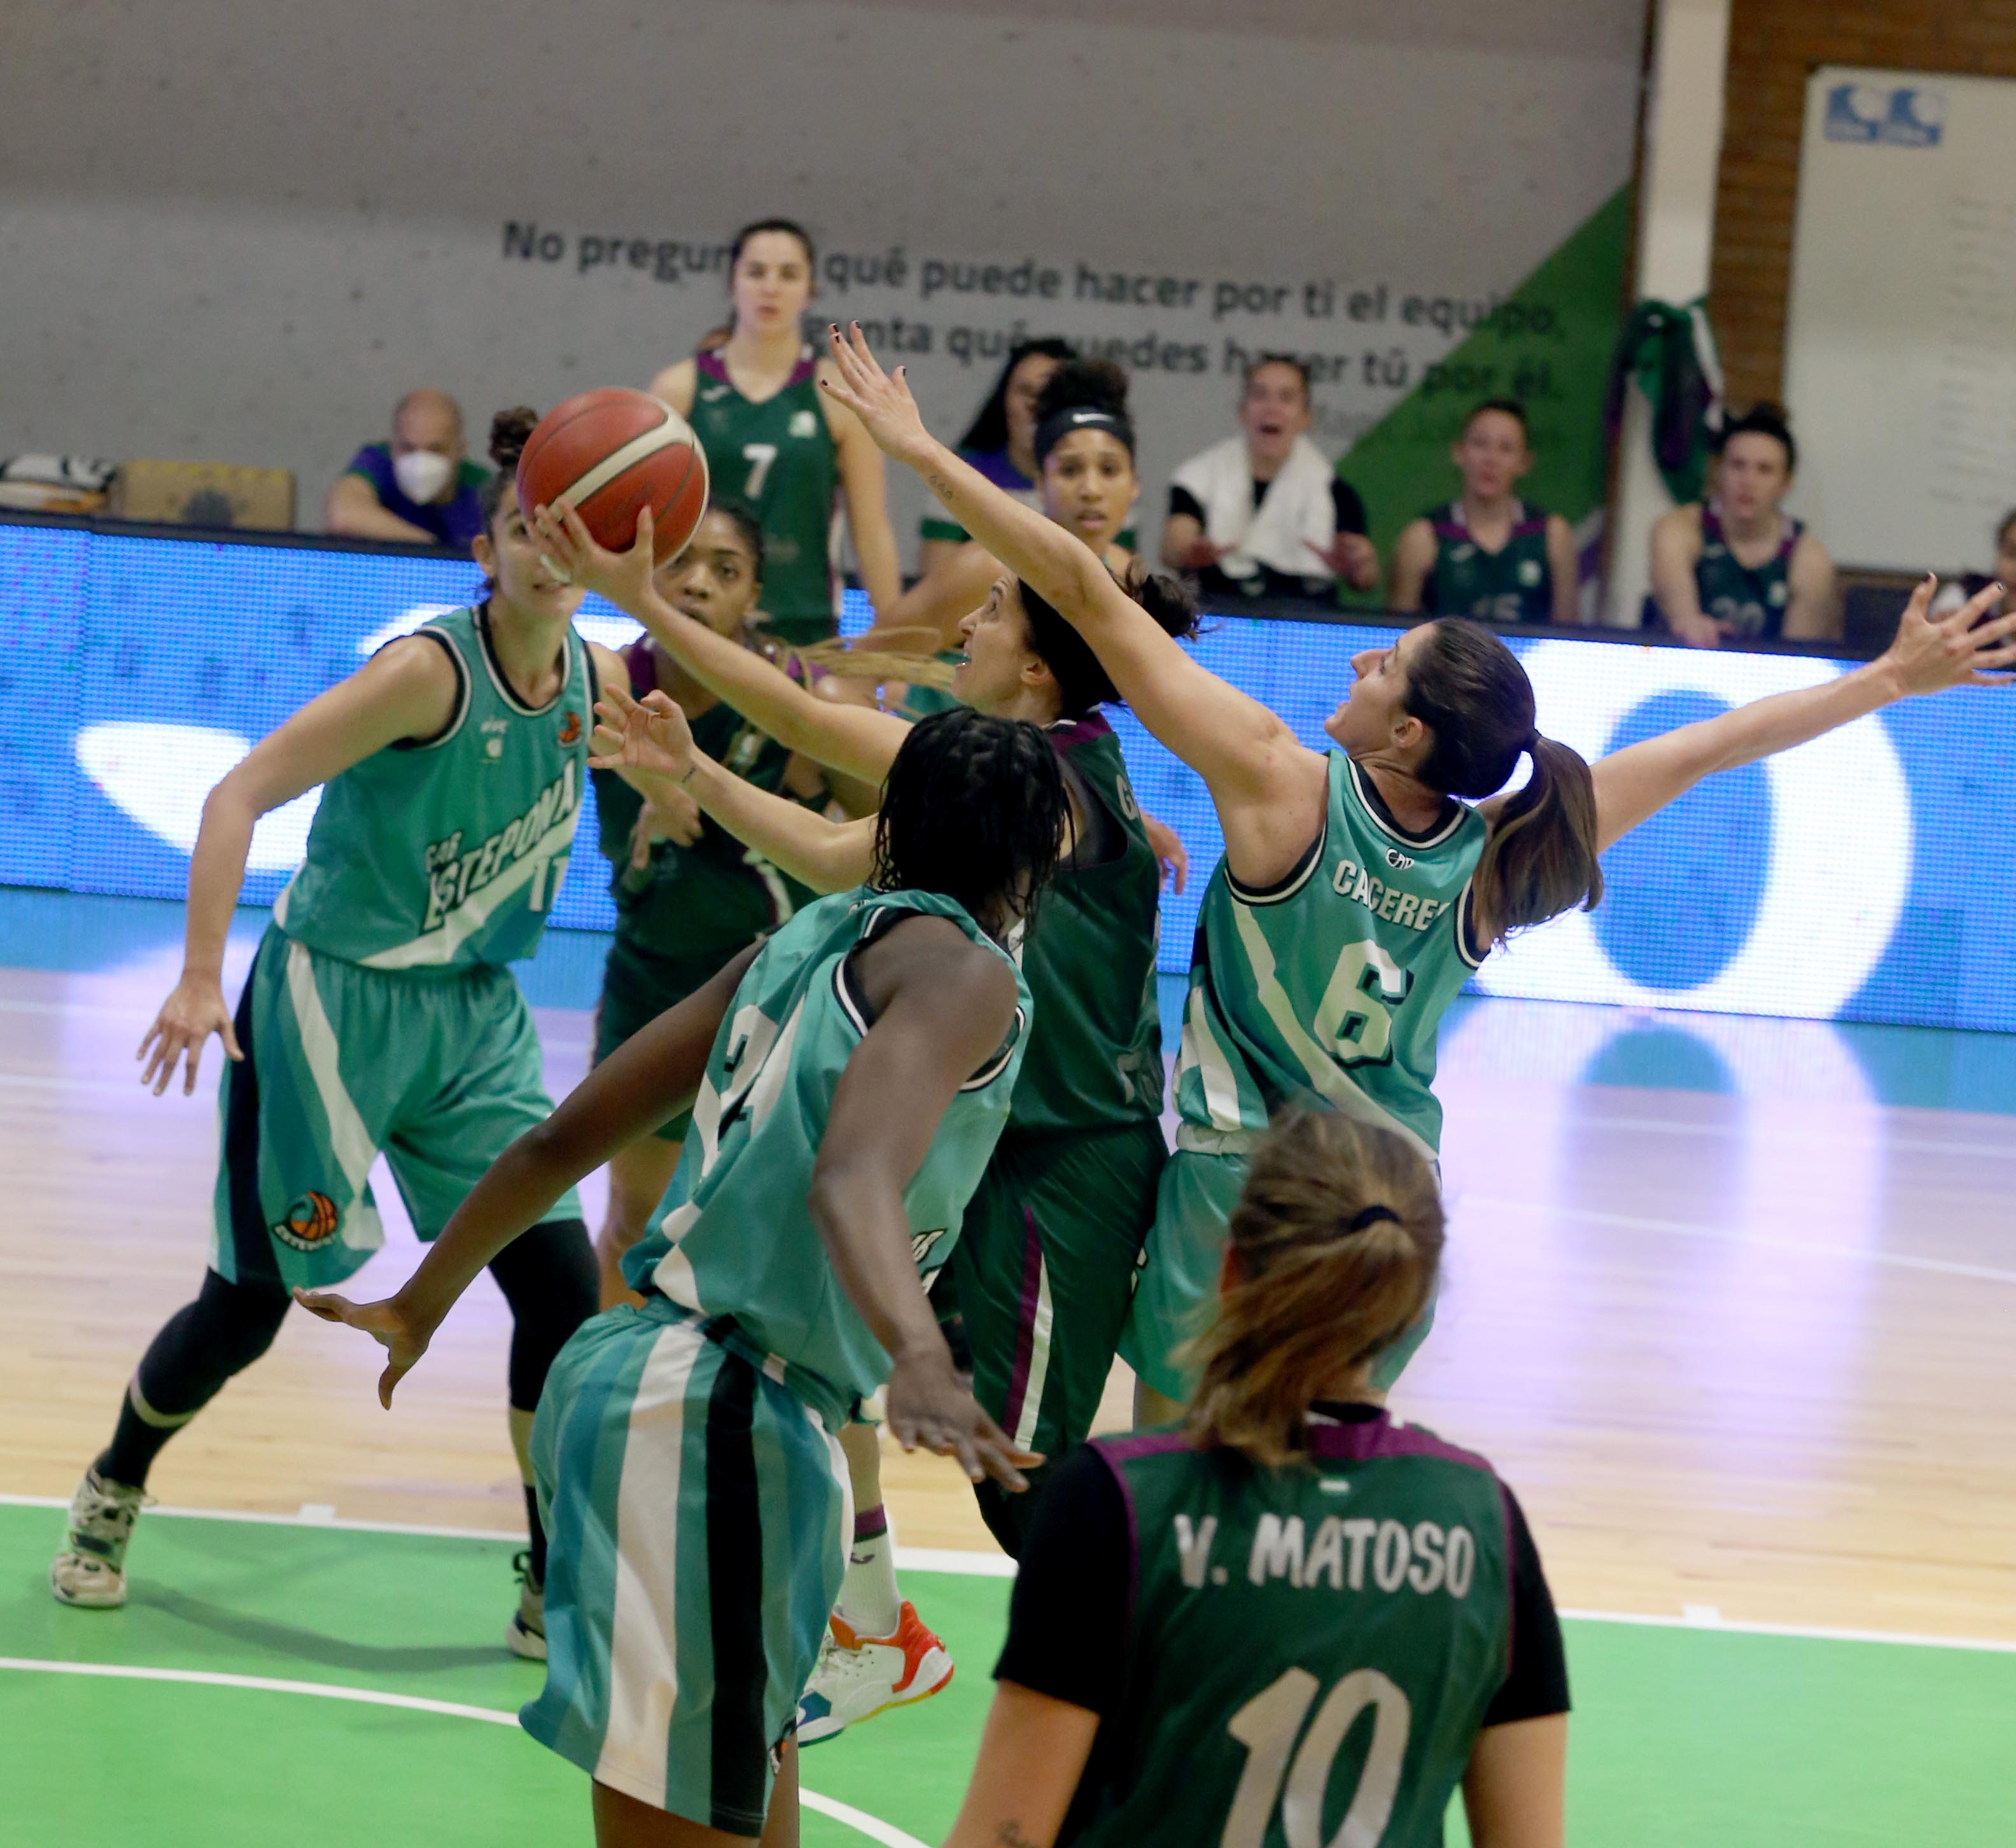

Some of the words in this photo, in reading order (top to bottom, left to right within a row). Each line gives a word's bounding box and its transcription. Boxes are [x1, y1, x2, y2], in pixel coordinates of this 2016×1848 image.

[503, 220, 565, 263] No
[579, 235, 729, 284] pregun
[824, 248, 907, 288] qué
[921, 256, 1061, 298] puede
[1076, 261, 1201, 309] hacer
[1214, 279, 1292, 323] por
[1302, 278, 1337, 320] ti
[1346, 281, 1390, 323] el
[1072, 328, 1208, 374] uedes
[1223, 333, 1350, 385] her
[1362, 344, 1410, 388] tú
[741, 443, 780, 500] 7
[1313, 939, 1408, 1065] 6
[1173, 1513, 1228, 1589] V.
[1247, 1512, 1476, 1599] MATOSO
[1220, 1665, 1411, 1848] 10
